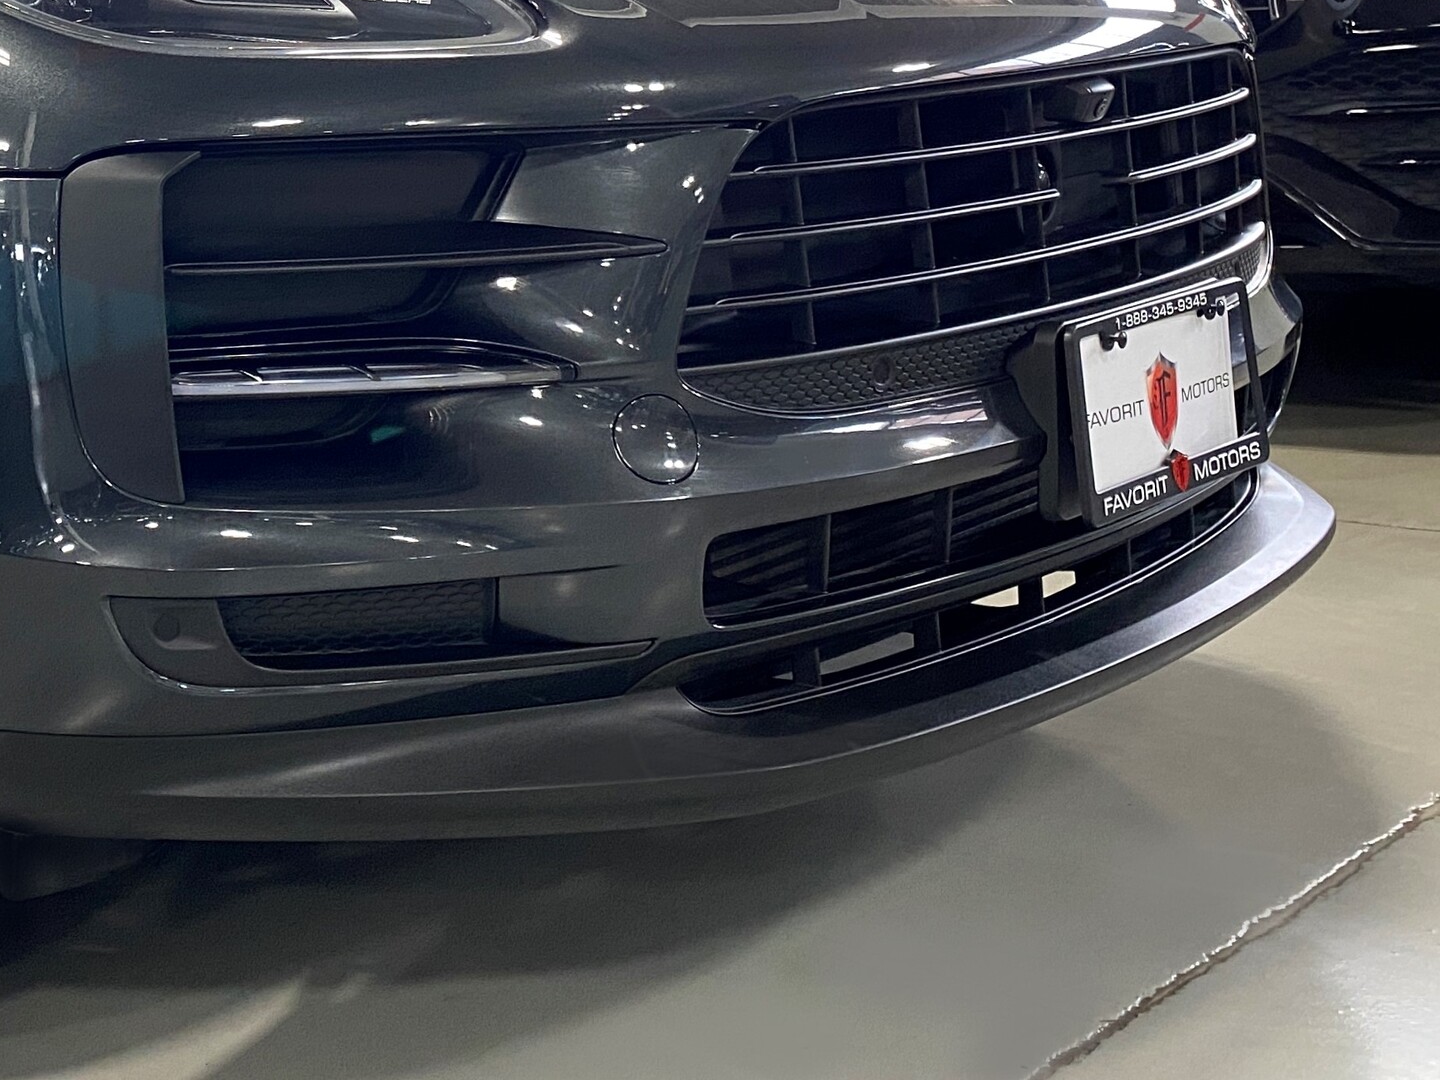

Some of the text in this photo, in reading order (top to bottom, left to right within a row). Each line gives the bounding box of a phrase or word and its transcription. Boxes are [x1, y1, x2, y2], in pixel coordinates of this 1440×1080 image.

[1115, 292, 1208, 330] 1-888-345-9345
[1181, 372, 1230, 403] MOTORS
[1103, 475, 1169, 516] FAVORIT
[1193, 441, 1261, 481] MOTORS
